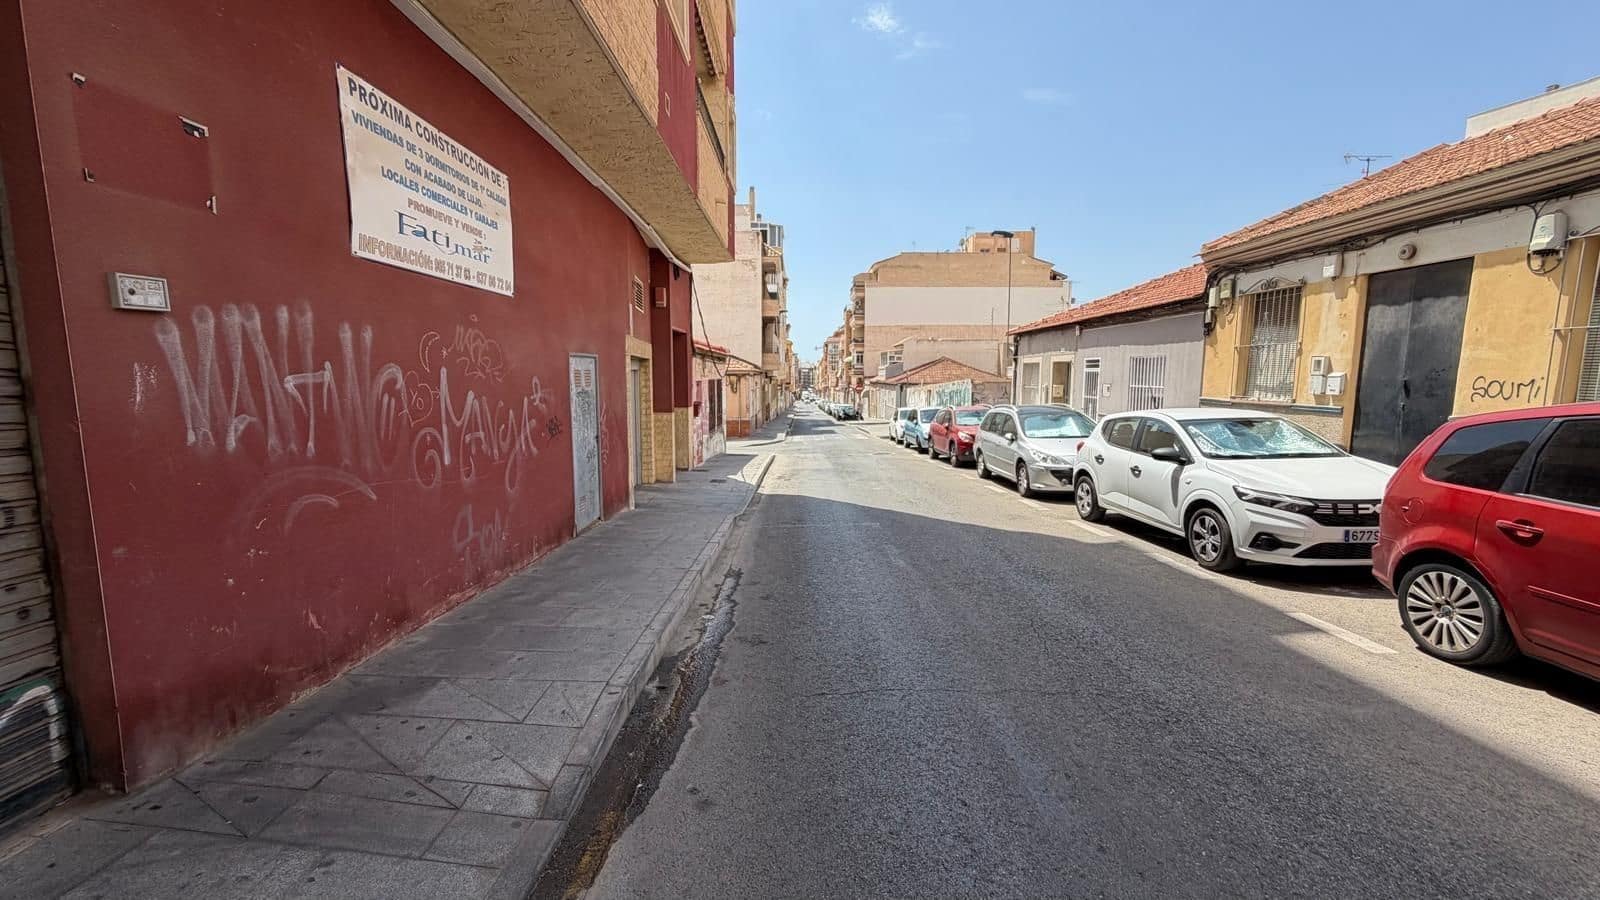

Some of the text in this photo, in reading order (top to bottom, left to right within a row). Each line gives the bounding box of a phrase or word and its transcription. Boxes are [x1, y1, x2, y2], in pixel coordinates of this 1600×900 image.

[347, 76, 413, 132] PRÓXIMA
[415, 121, 490, 180] CONSTRUCCIÓN
[351, 109, 404, 148] VIVIENDAS
[406, 140, 417, 156] DE
[418, 147, 424, 160] 3
[425, 152, 470, 187] DORMITORIOS
[381, 165, 499, 230] LOCALES COMERCIALES Y GARAJES
[405, 158, 422, 176] CON
[424, 169, 457, 194] ACABADO
[457, 187, 467, 200] DE
[407, 197, 453, 226] PROMUEVE
[454, 218, 460, 229] Y
[358, 233, 433, 271] INFORMACIÓN:
